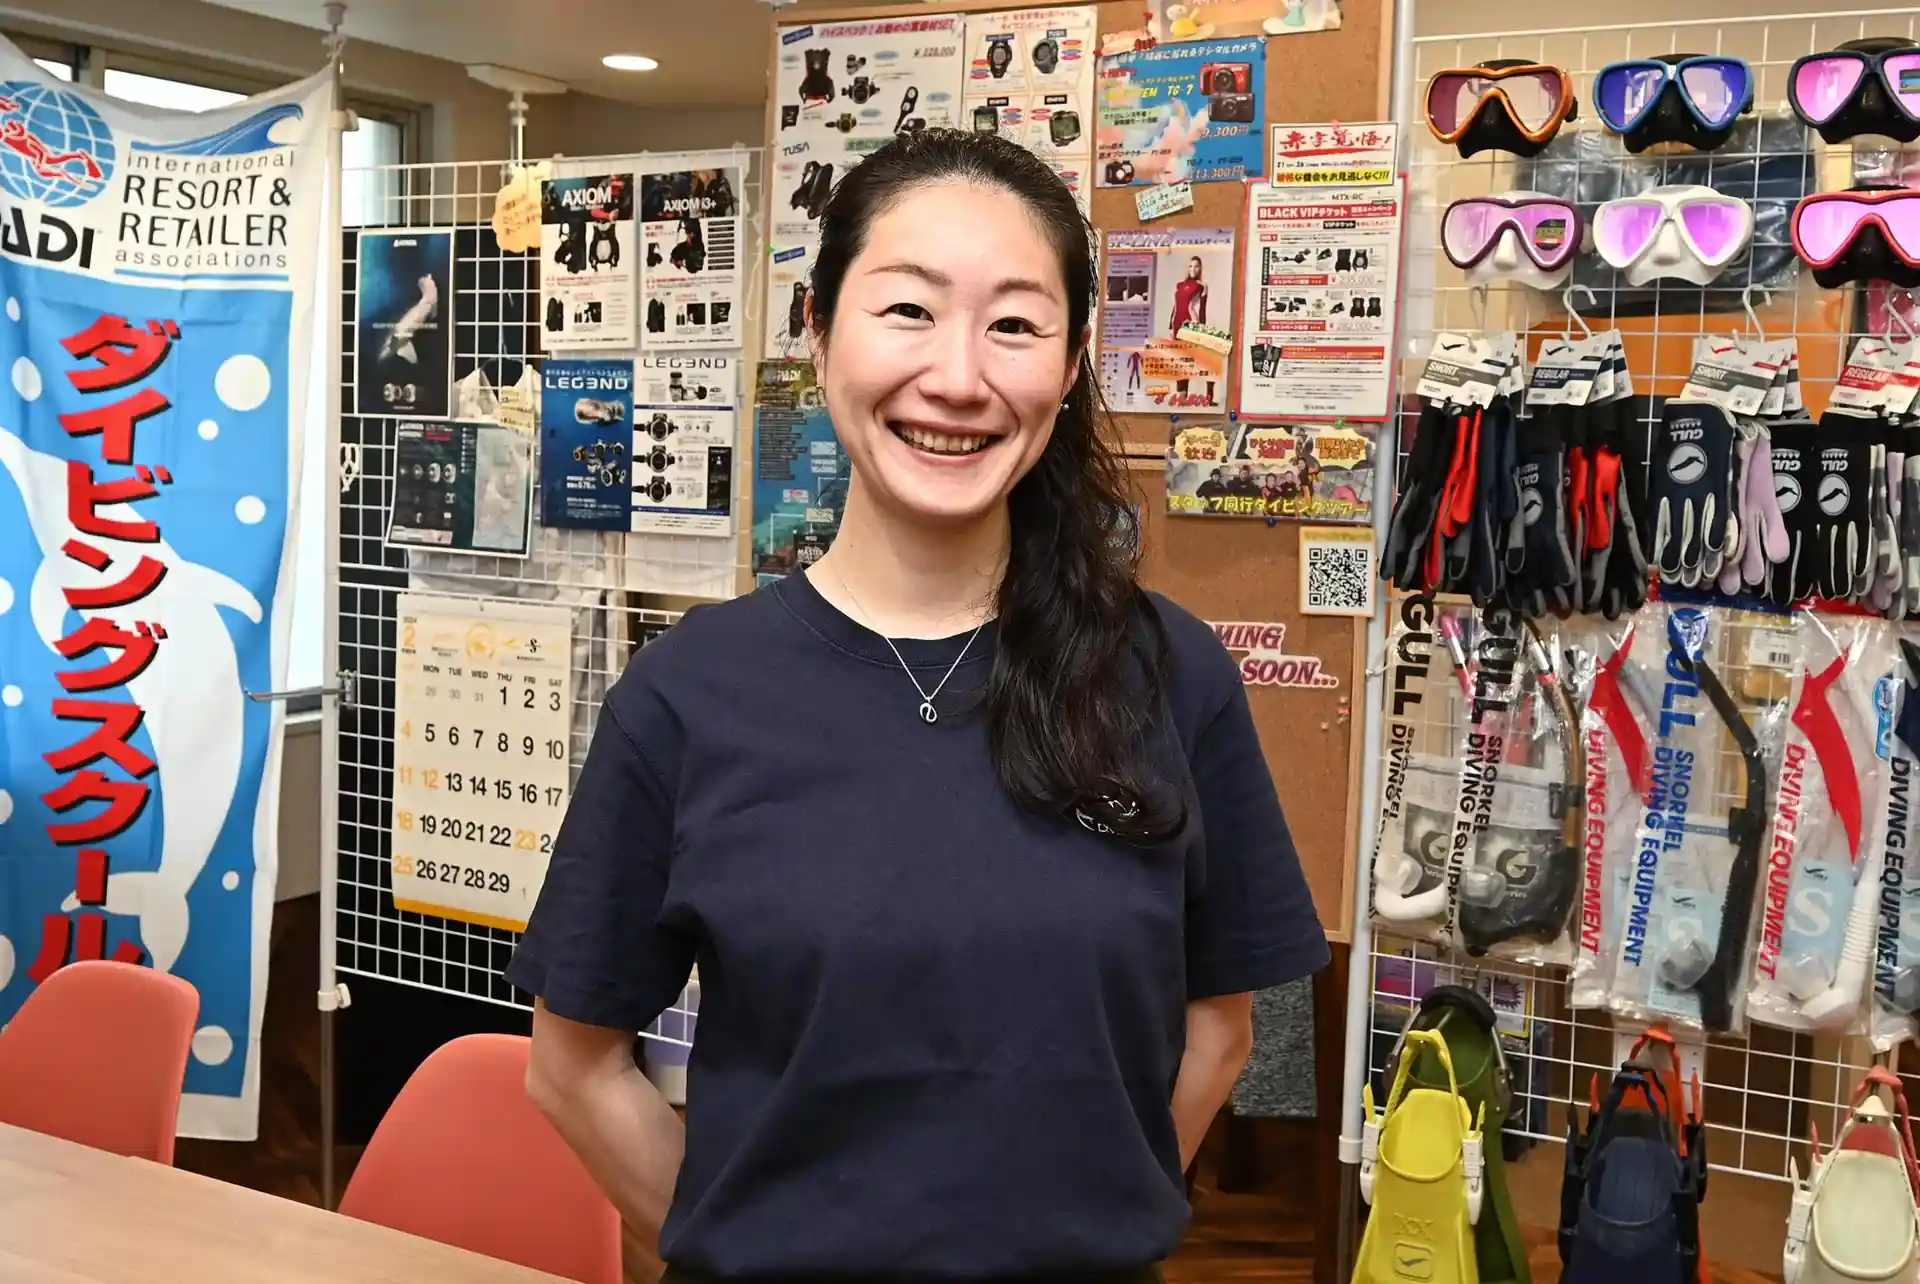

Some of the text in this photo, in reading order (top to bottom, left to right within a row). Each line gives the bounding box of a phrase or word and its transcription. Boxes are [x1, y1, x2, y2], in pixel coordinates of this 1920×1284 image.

[127, 149, 295, 175] international
[783, 142, 810, 157] TUSA
[123, 174, 292, 211] RESORT &
[561, 186, 613, 206] AXIOM
[663, 197, 699, 212] AXIOM
[118, 212, 288, 248] RETAILER
[1259, 206, 1298, 219] BLACK
[0, 206, 96, 270] ADI
[115, 249, 288, 269] associations
[1427, 361, 1460, 377] SHORT
[1670, 428, 1704, 442] GULL
[1772, 460, 1802, 471] GUL
[1821, 460, 1849, 472] GULL
[40, 313, 182, 984] ダイビングスクール
[1393, 593, 1434, 715] GULL
[423, 665, 440, 674] MON
[448, 667, 462, 677] TUE
[471, 671, 488, 679] WED
[497, 673, 512, 682] THU
[523, 677, 536, 685] FRI
[500, 687, 508, 706] 1
[524, 689, 536, 709] 2
[550, 691, 562, 712] 3
[425, 723, 436, 743] 5
[449, 726, 460, 746] 6
[473, 729, 484, 749] 7
[498, 732, 509, 753] 8
[523, 736, 534, 756] 9
[546, 739, 565, 760] 10
[1385, 723, 1408, 801] DIVING
[1460, 732, 1486, 813] DIVING
[399, 766, 563, 807] 11 12 13 14 15 16 17
[1472, 735, 1503, 834] SNORKEL
[1663, 750, 1695, 853] SNORKEL
[420, 815, 437, 835] 19
[441, 818, 462, 839] 20
[466, 821, 485, 843] 21
[490, 825, 512, 847] 22
[516, 830, 537, 851] 23
[1624, 746, 1673, 967] DIVING EQUIPMENT
[416, 859, 437, 881] 26
[440, 863, 461, 884] 27
[464, 867, 485, 889] 28
[489, 871, 510, 894] 29
[1581, 816, 1607, 956] EQUIPMENT
[1874, 757, 1912, 1002] DIVING EQUIPMENT
[1759, 833, 1795, 981] EQUIPMENT
